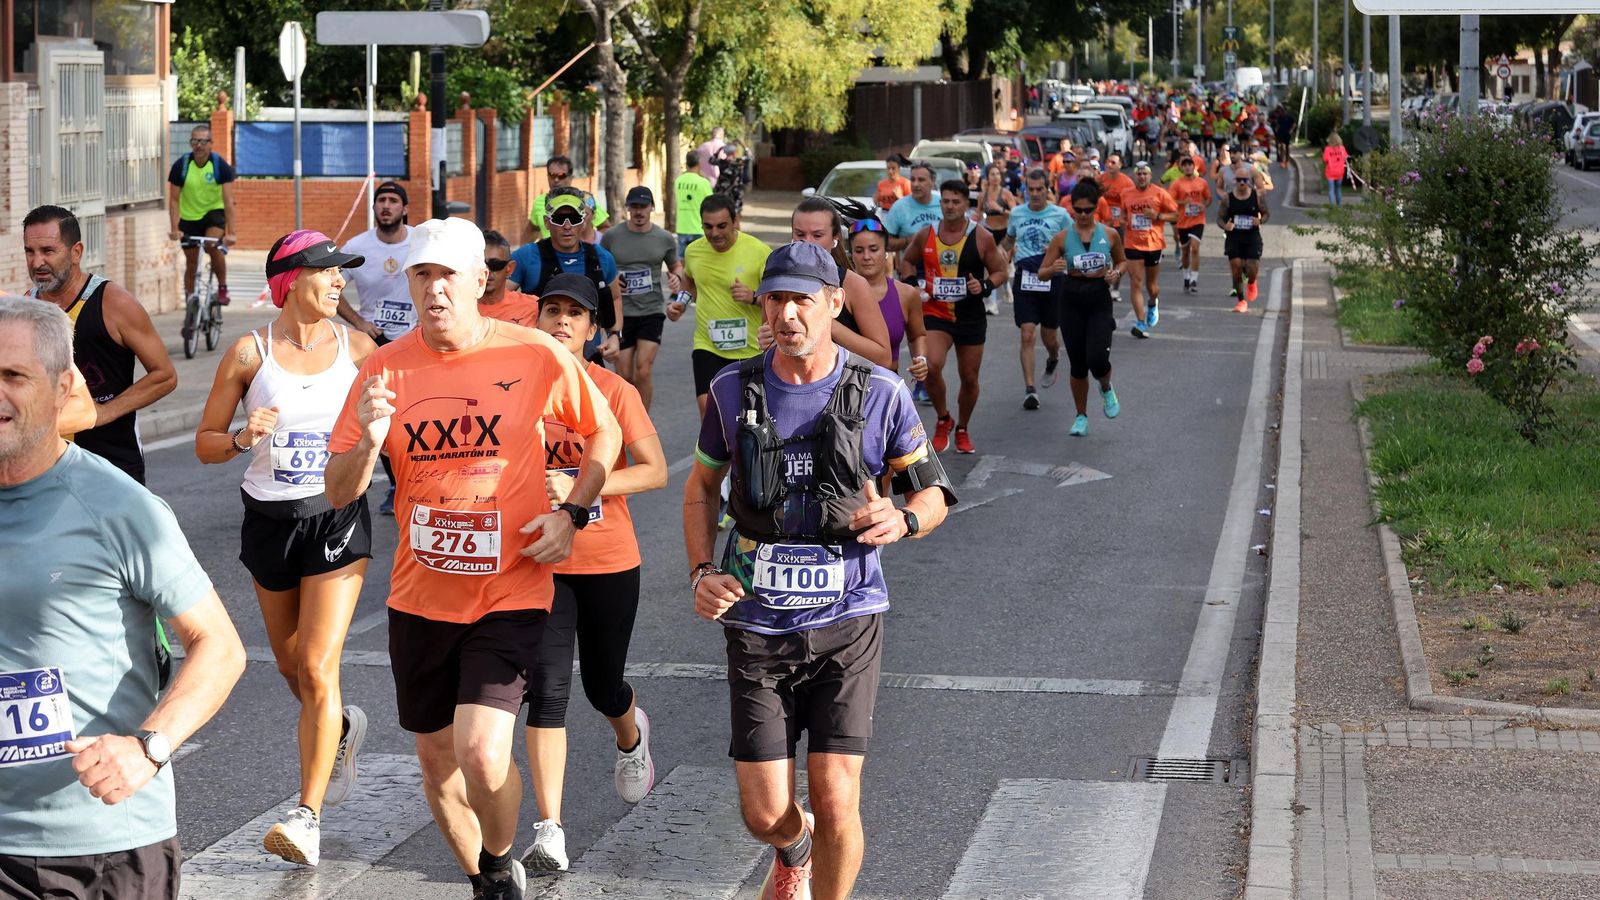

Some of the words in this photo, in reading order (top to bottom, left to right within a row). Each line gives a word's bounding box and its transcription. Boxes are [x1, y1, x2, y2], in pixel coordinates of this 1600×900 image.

[939, 286, 961, 294] 1042
[380, 310, 405, 321] 1062
[721, 330, 734, 340] 16
[403, 414, 502, 453] XXIX
[486, 449, 499, 457] DE
[290, 450, 330, 468] 692
[434, 519, 457, 529] XXIX
[431, 530, 477, 554] 276
[777, 555, 800, 563] XXIX
[767, 566, 829, 589] 1100
[6, 701, 50, 735] 16
